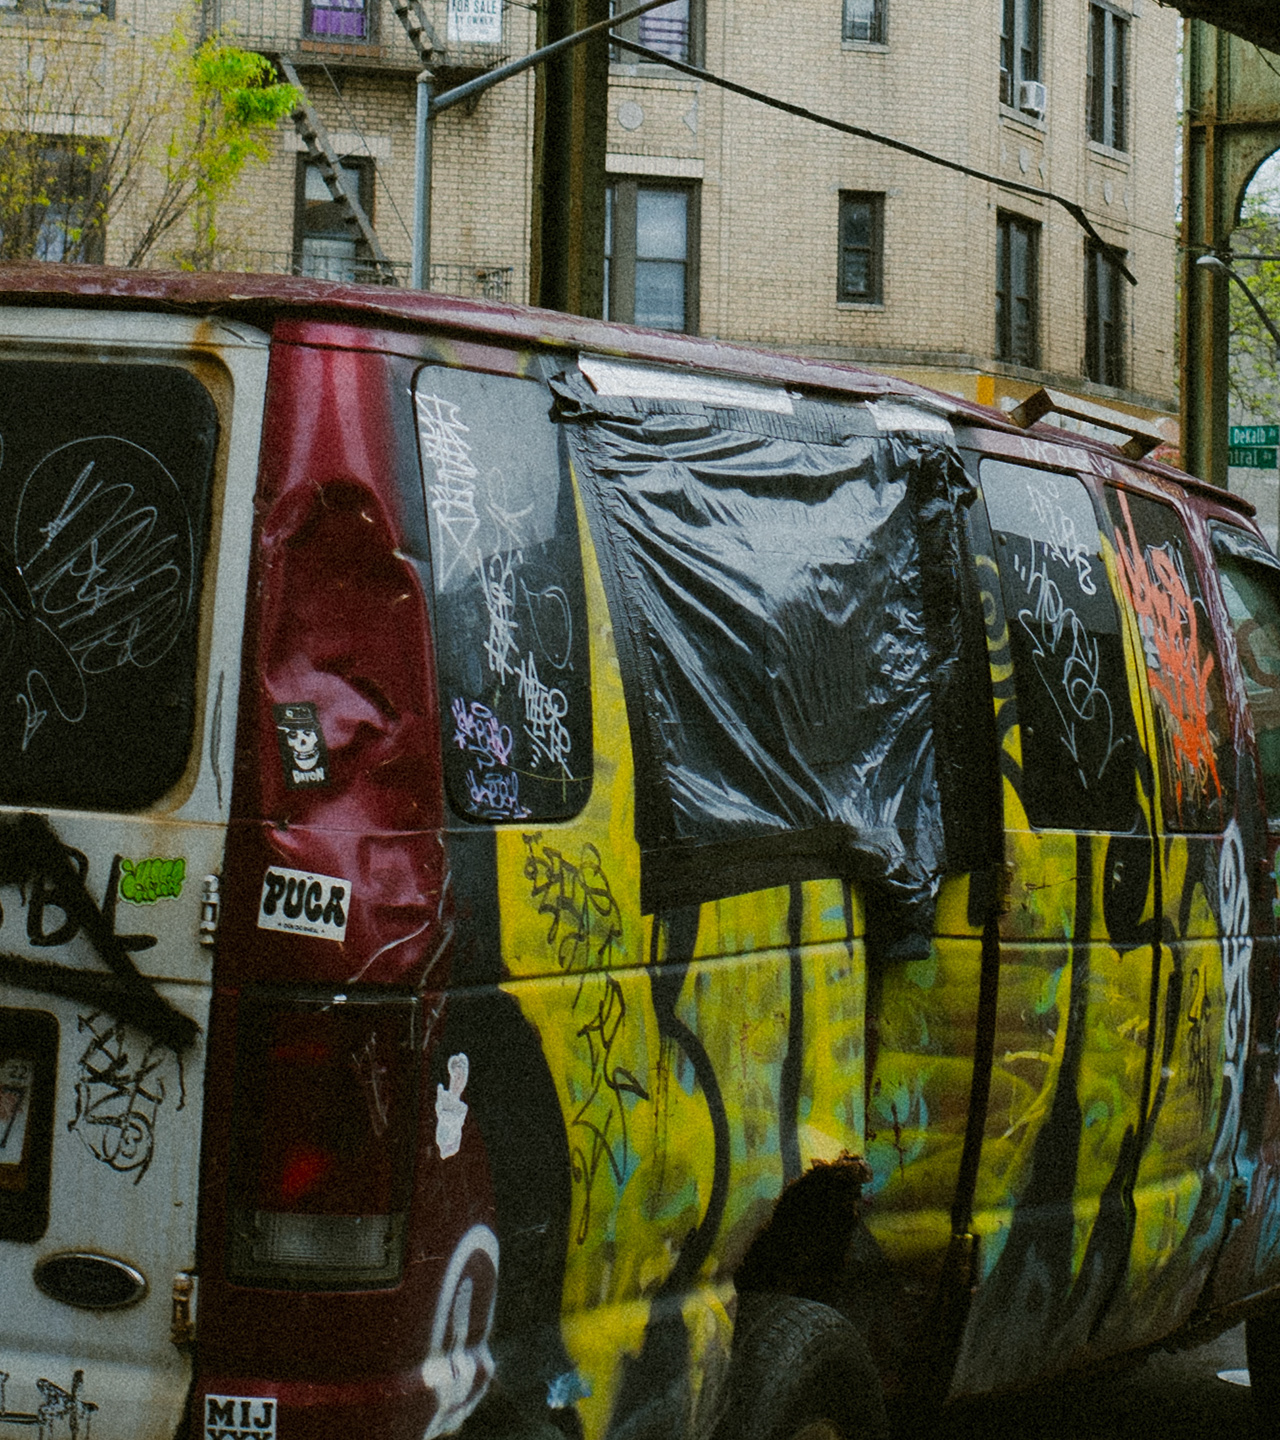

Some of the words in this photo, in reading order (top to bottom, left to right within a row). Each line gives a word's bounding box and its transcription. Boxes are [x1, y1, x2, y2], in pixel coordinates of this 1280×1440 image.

[473, 0, 497, 15] SALE
[1234, 427, 1266, 444] DeKalb
[1228, 448, 1258, 466] ntral
[263, 872, 345, 928] PUCA
[208, 1399, 273, 1429] MIJ
